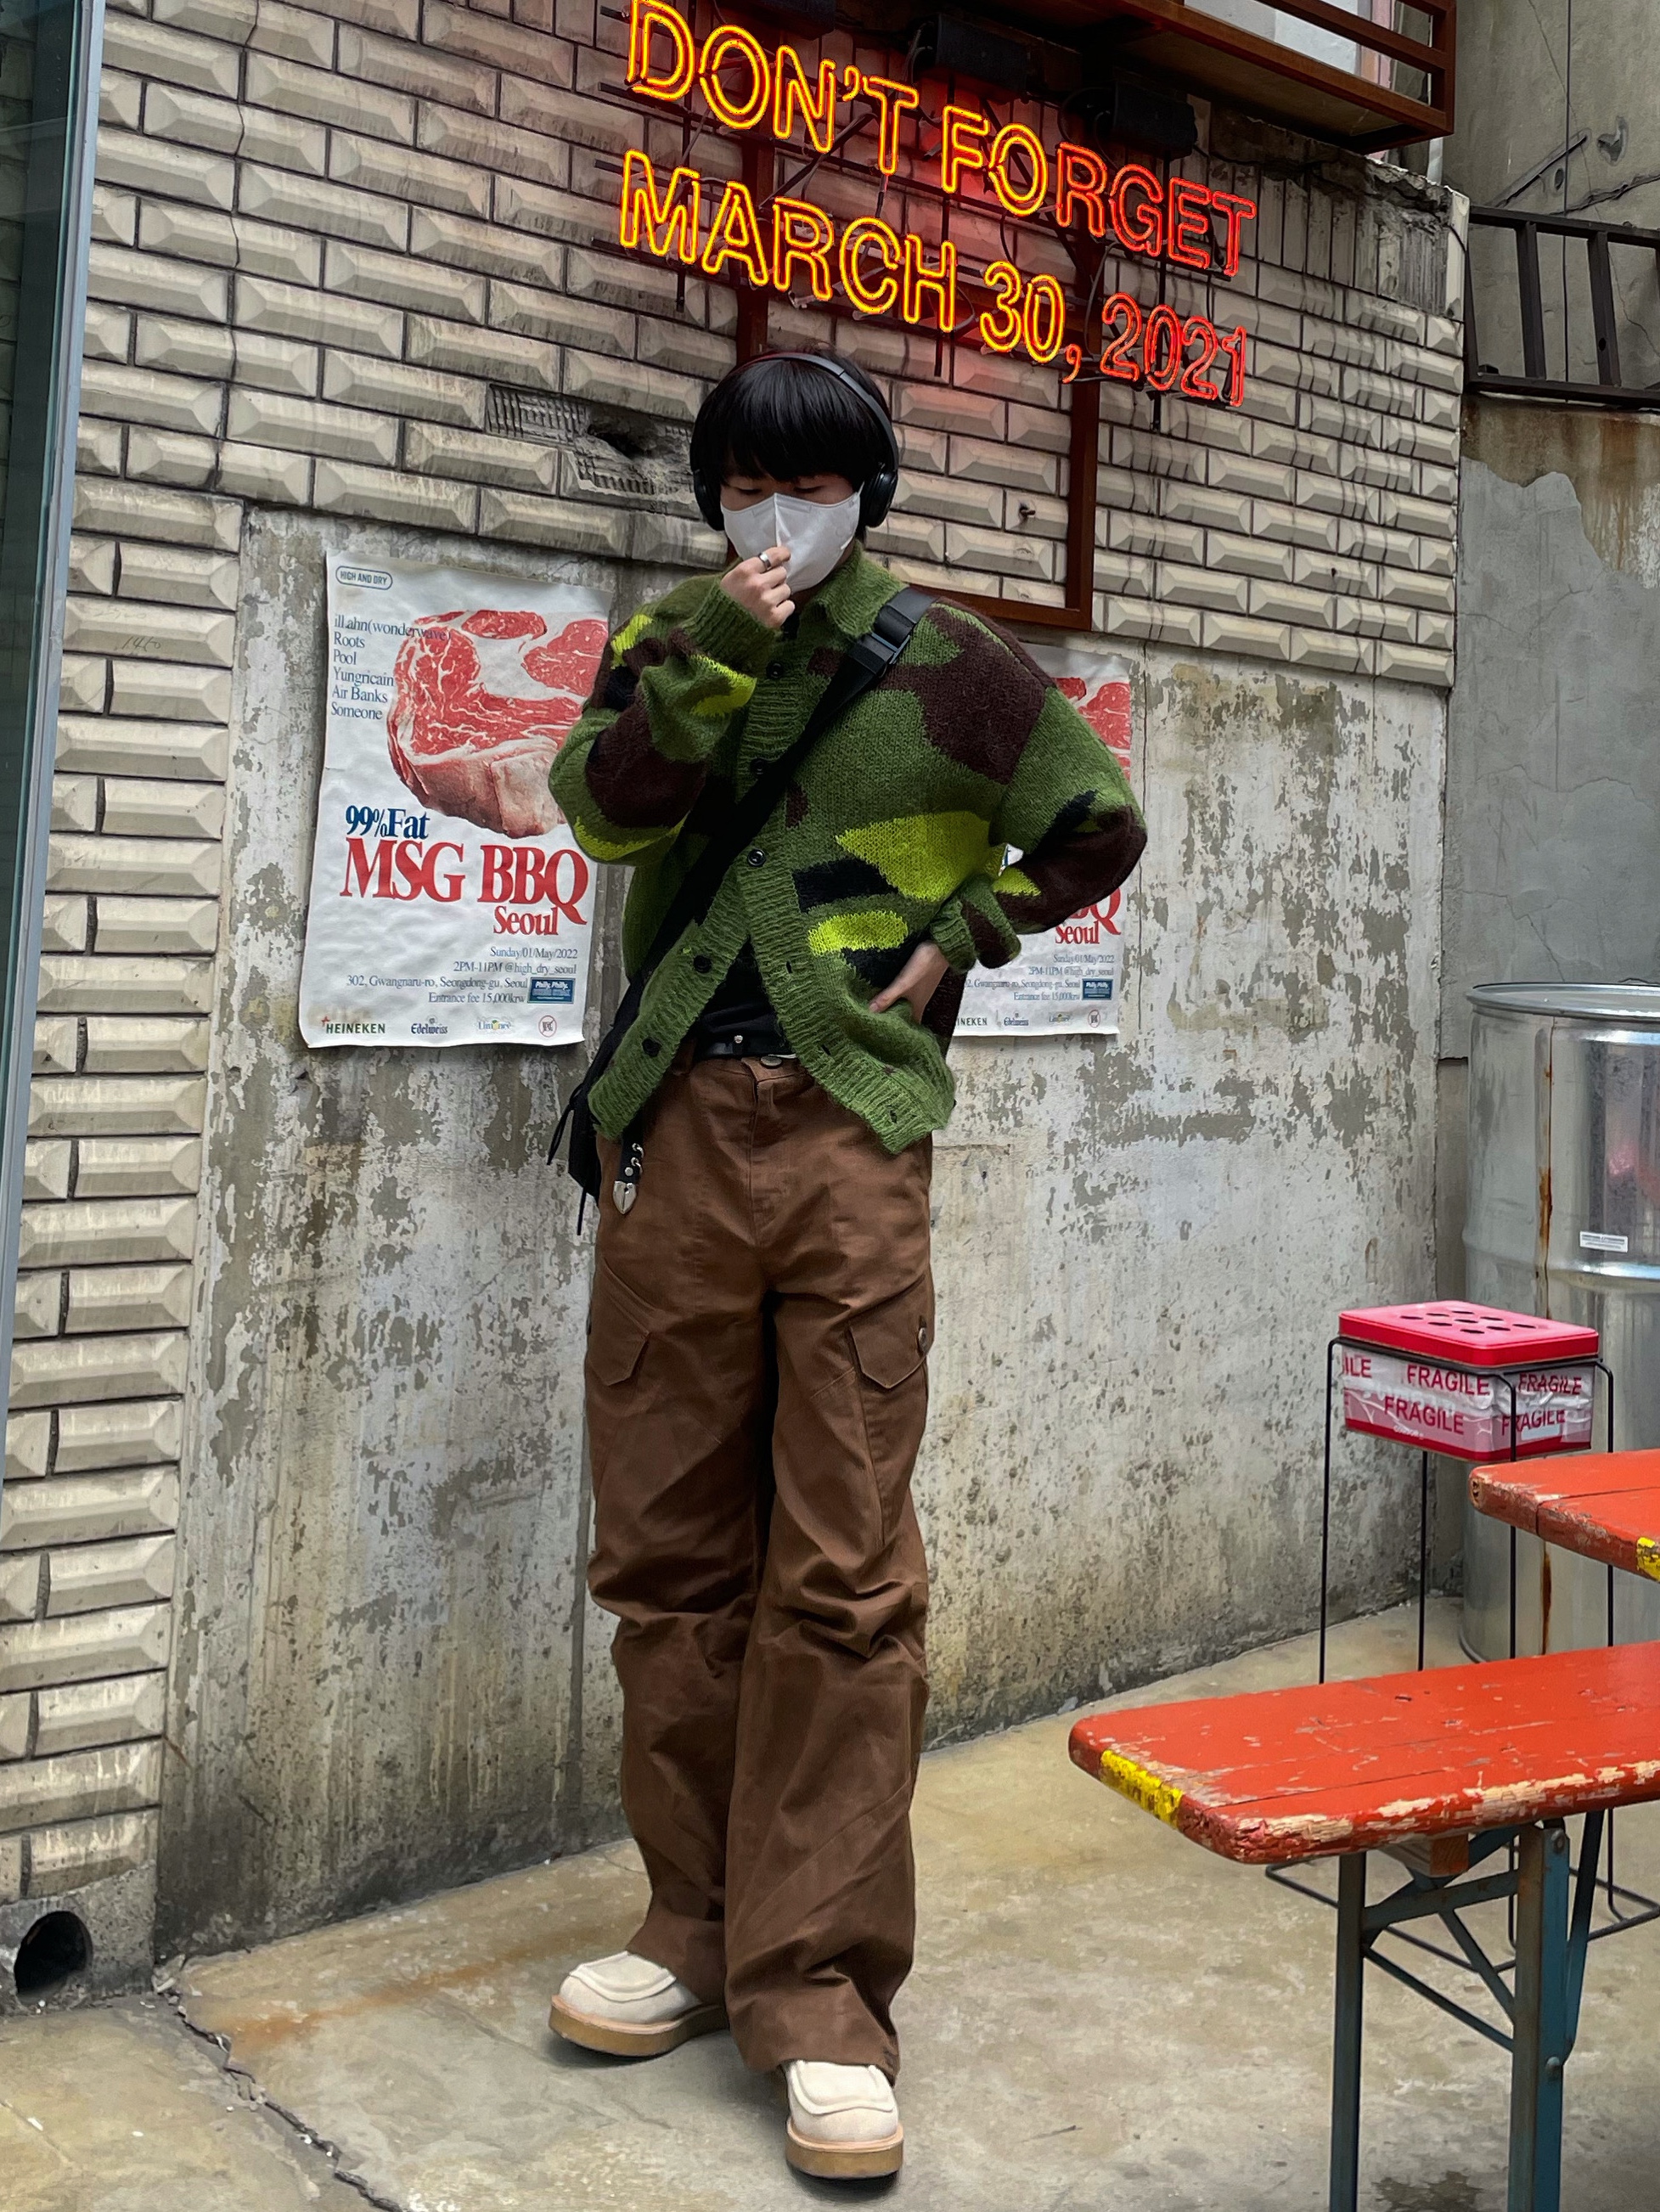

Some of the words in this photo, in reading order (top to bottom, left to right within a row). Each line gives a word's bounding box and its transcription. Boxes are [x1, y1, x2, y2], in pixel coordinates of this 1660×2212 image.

[627, 0, 919, 175] DON'T
[941, 105, 1257, 277] FORGET
[620, 149, 956, 333] MARCH
[979, 260, 1083, 385] 30,
[1099, 291, 1248, 408] 2021
[340, 570, 356, 582] HIGH
[357, 572, 372, 584] AND
[373, 575, 387, 586] DRY
[333, 631, 366, 649] Roots
[333, 649, 357, 665] Pool
[333, 667, 394, 687] Yungricain
[331, 684, 348, 699] Air
[351, 686, 388, 703] Banks
[330, 701, 384, 720] Someone
[339, 836, 466, 902] MSG
[477, 844, 589, 926] BBQ
[492, 905, 559, 936] Seoul
[453, 960, 503, 972] 2PM-11PM
[504, 962, 577, 976] @high_dry_seoul
[504, 977, 528, 988] Seoul
[428, 992, 465, 1003] Entrance
[467, 992, 480, 1003] fee
[325, 1022, 386, 1034] HEINEKEN
[410, 1023, 448, 1034] Edelweiss
[1406, 1364, 1490, 1395] FRAGILE
[1517, 1372, 1582, 1395] FRAGILE
[1384, 1395, 1465, 1435] FRAGILE
